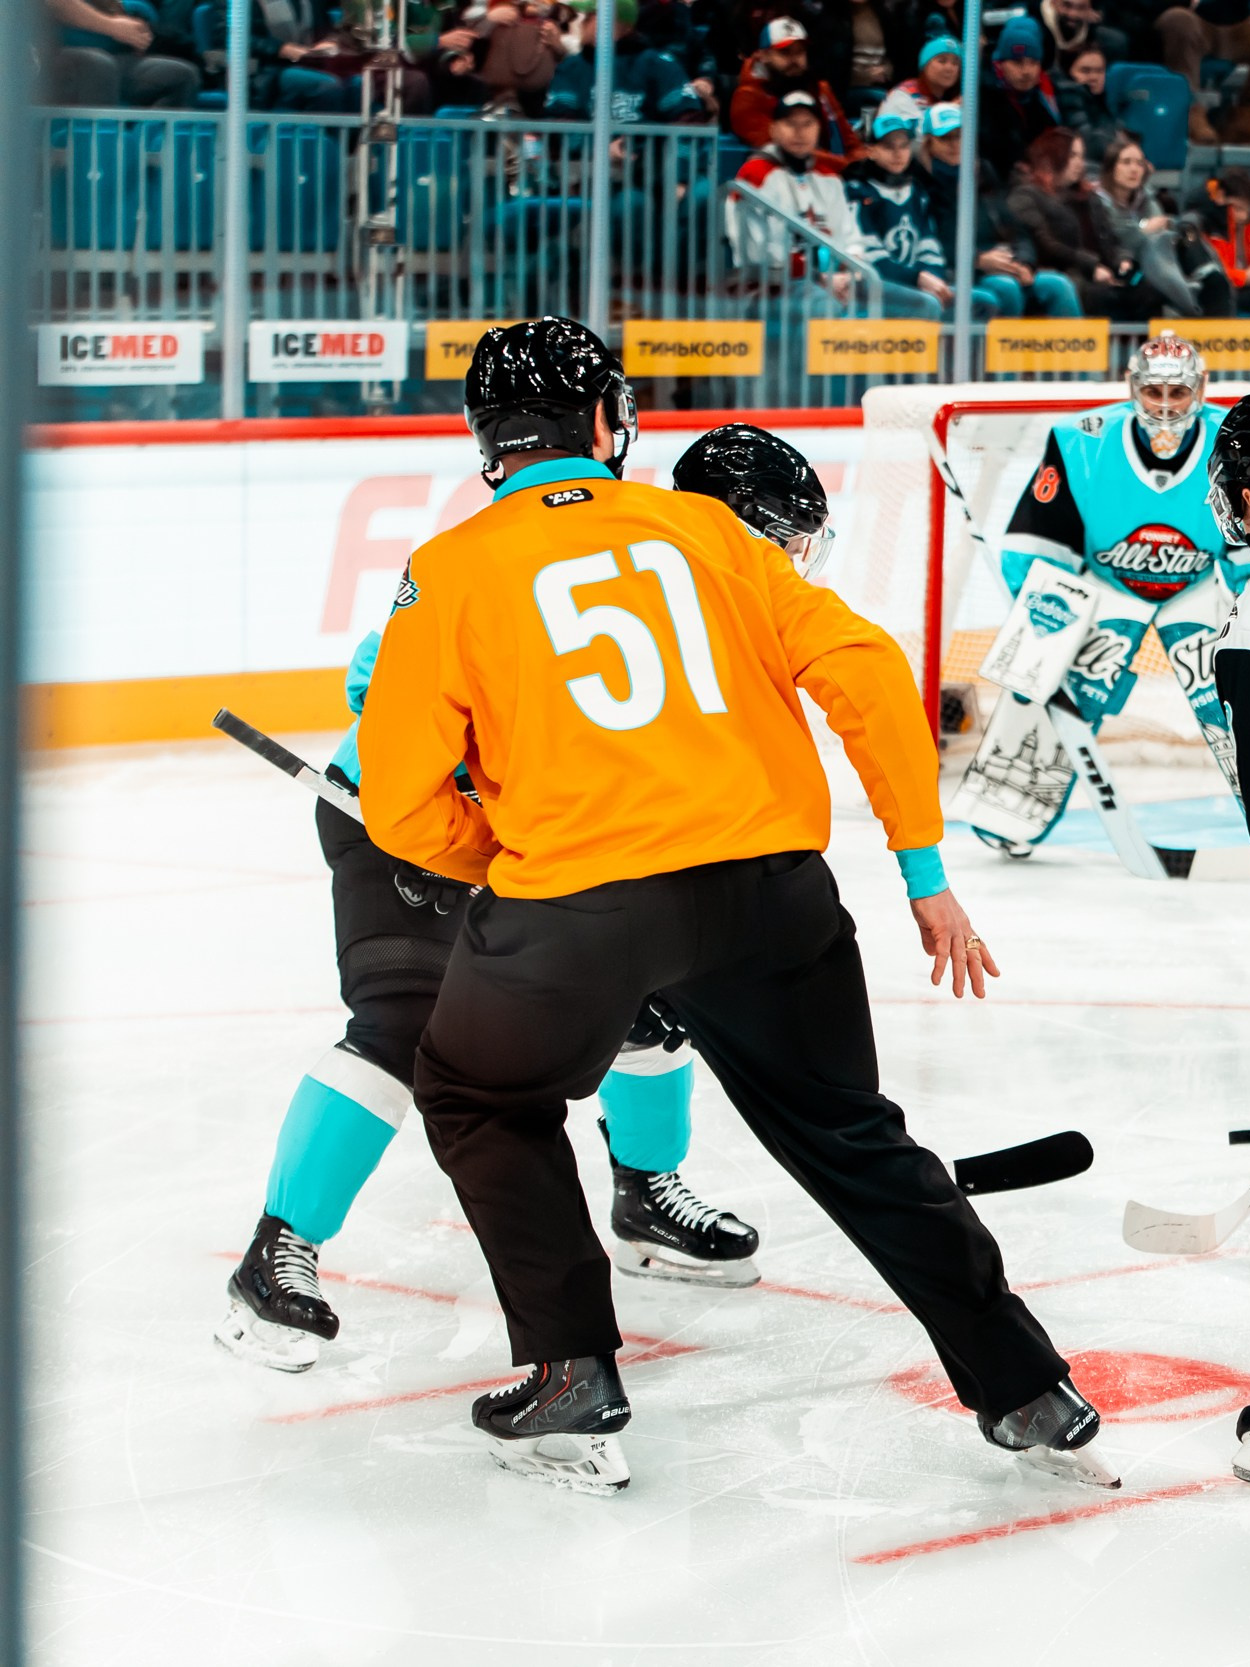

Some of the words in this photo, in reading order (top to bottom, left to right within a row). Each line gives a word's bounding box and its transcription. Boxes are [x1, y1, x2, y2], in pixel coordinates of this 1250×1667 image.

[60, 334, 179, 361] ICEMED
[272, 332, 385, 358] ICEMED
[638, 341, 749, 357] ТИНЬКОФФ
[820, 338, 927, 354] ТИНЬКОФФ
[996, 337, 1098, 352] ТИНЬКОФФ
[497, 435, 539, 447] TRUE
[1031, 462, 1060, 503] 8
[757, 505, 793, 525] TRUE
[1096, 541, 1212, 574] All-Star
[533, 540, 728, 731] 51
[512, 1399, 539, 1425] BAUER
[601, 1405, 631, 1420] BAUE
[1065, 1409, 1098, 1442] BAUER
